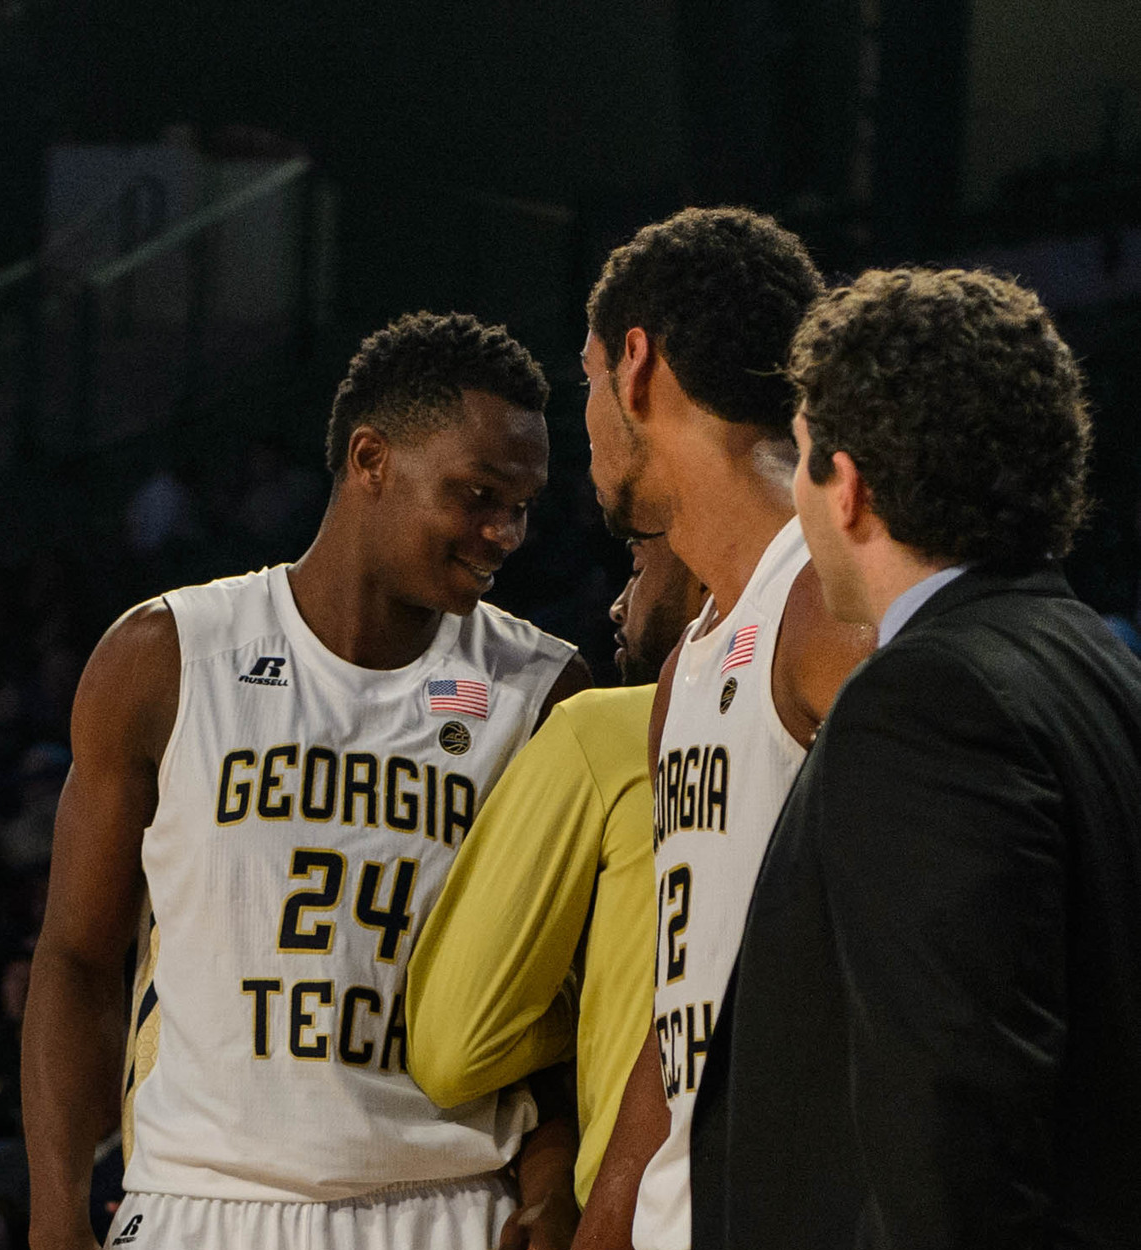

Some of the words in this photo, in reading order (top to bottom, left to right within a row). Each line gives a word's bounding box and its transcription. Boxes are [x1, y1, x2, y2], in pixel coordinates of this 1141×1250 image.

[237, 674, 289, 687] RUSSELL
[216, 743, 477, 850] GEORGIA
[654, 744, 730, 850] ORGIA
[277, 847, 421, 965] 24
[656, 1001, 714, 1100] ECH
